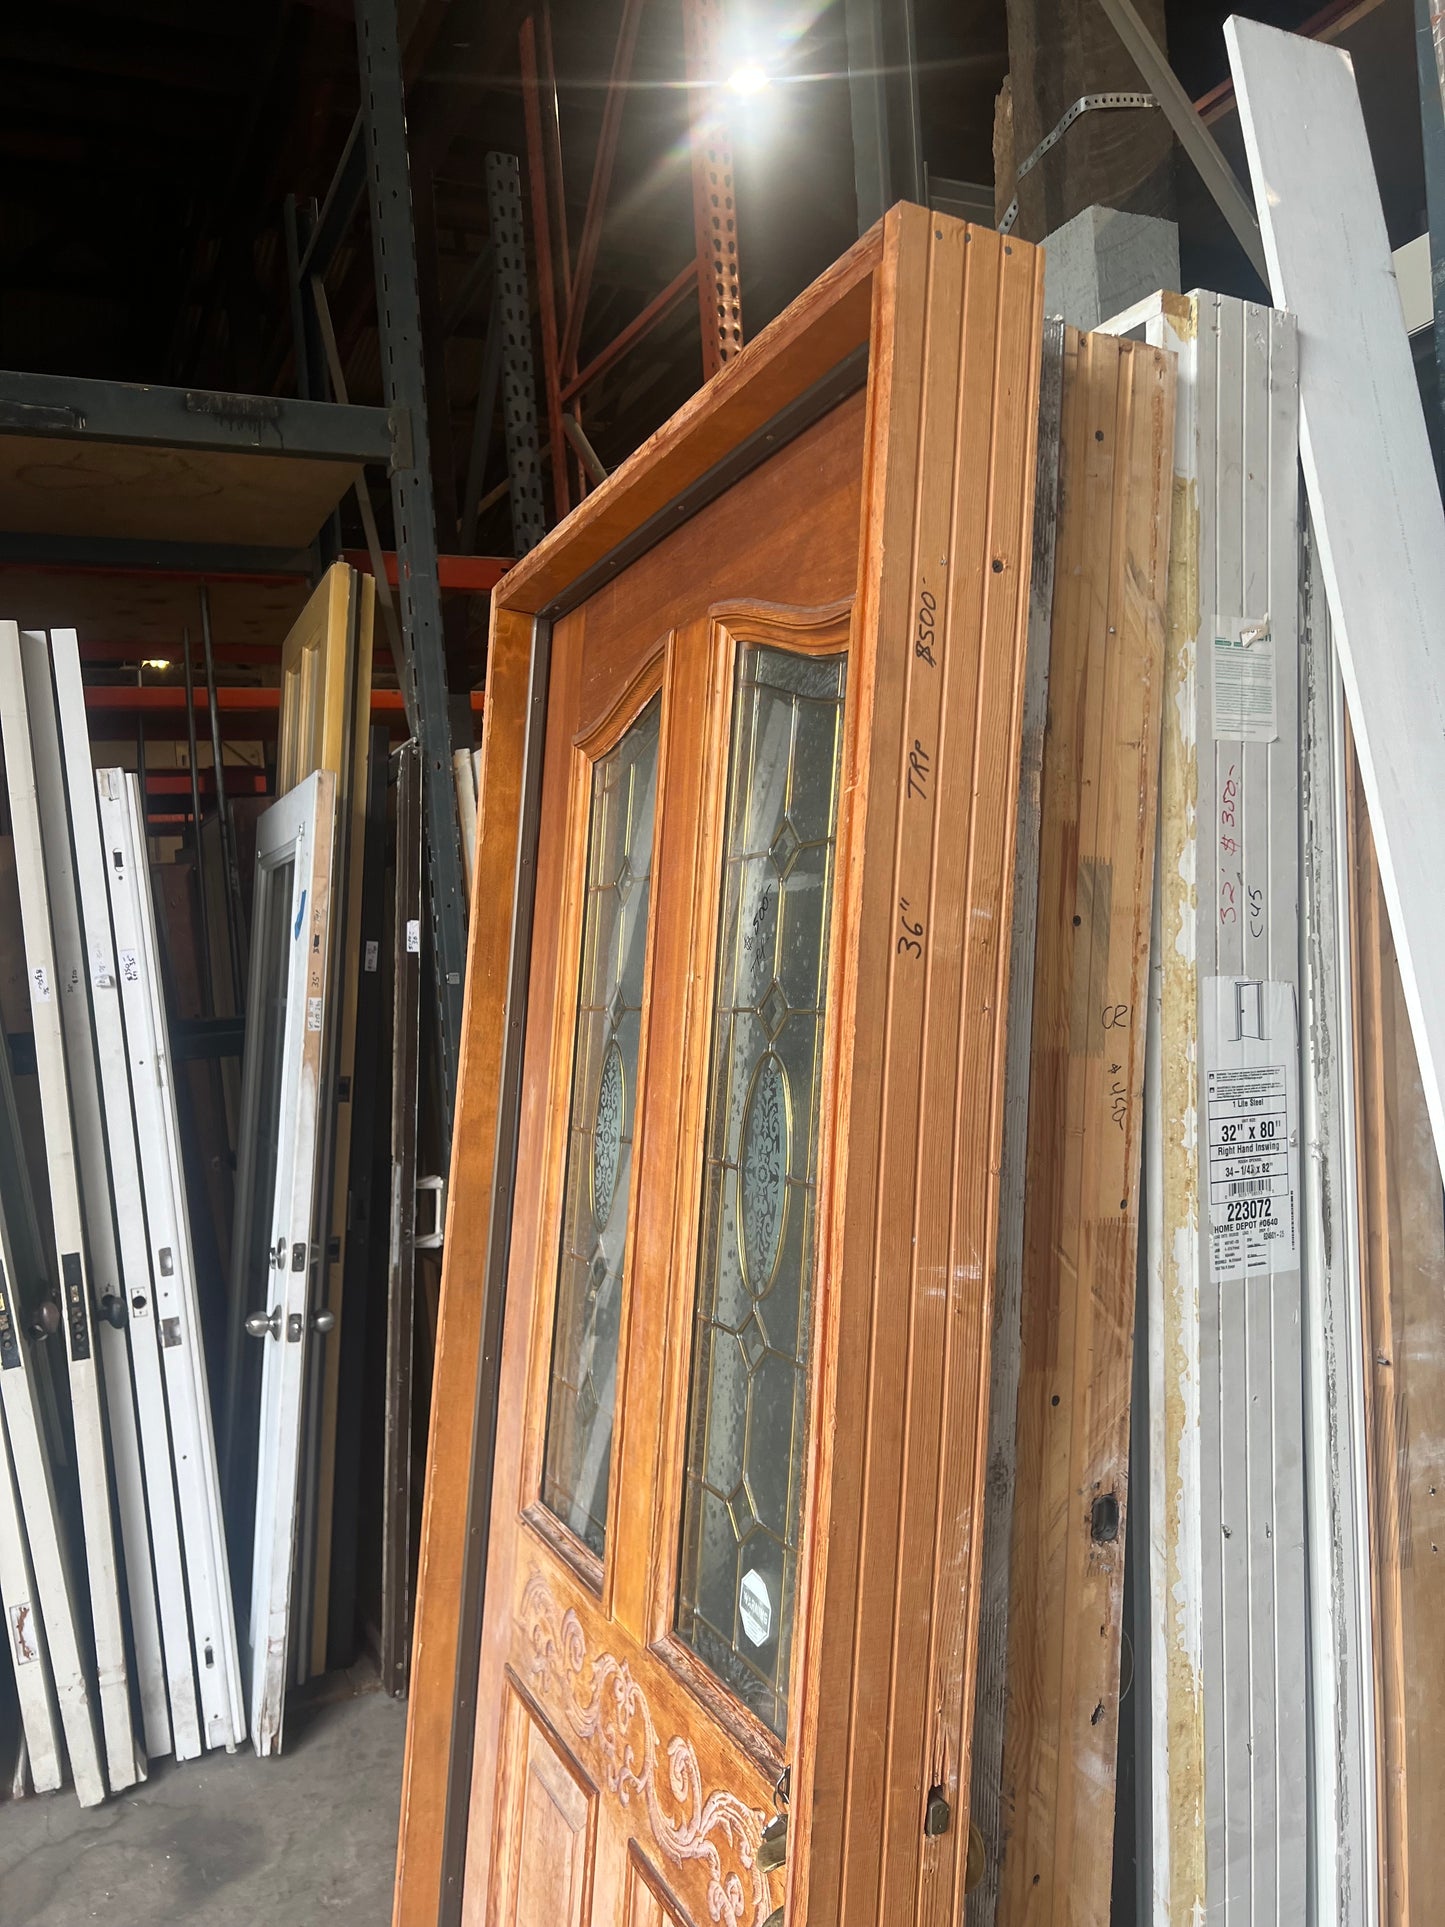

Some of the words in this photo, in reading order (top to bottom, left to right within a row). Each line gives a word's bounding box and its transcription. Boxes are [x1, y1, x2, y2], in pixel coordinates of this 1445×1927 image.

[908, 740, 930, 799] TRP
[897, 897, 924, 959] 36"
[1237, 1099, 1248, 1107] Lite
[1249, 1098, 1264, 1106] Steel
[1221, 1124, 1243, 1142] 32"
[1248, 1126, 1256, 1139] x
[1260, 1120, 1281, 1138] 80"
[1217, 1145, 1235, 1157] Right
[1237, 1143, 1254, 1153] Hand
[1255, 1142, 1280, 1152] Inswing
[1227, 1198, 1272, 1222] 223072
[1214, 1223, 1234, 1234] HOME
[1236, 1220, 1257, 1231] DEPOT
[1259, 1217, 1279, 1228] #0640
